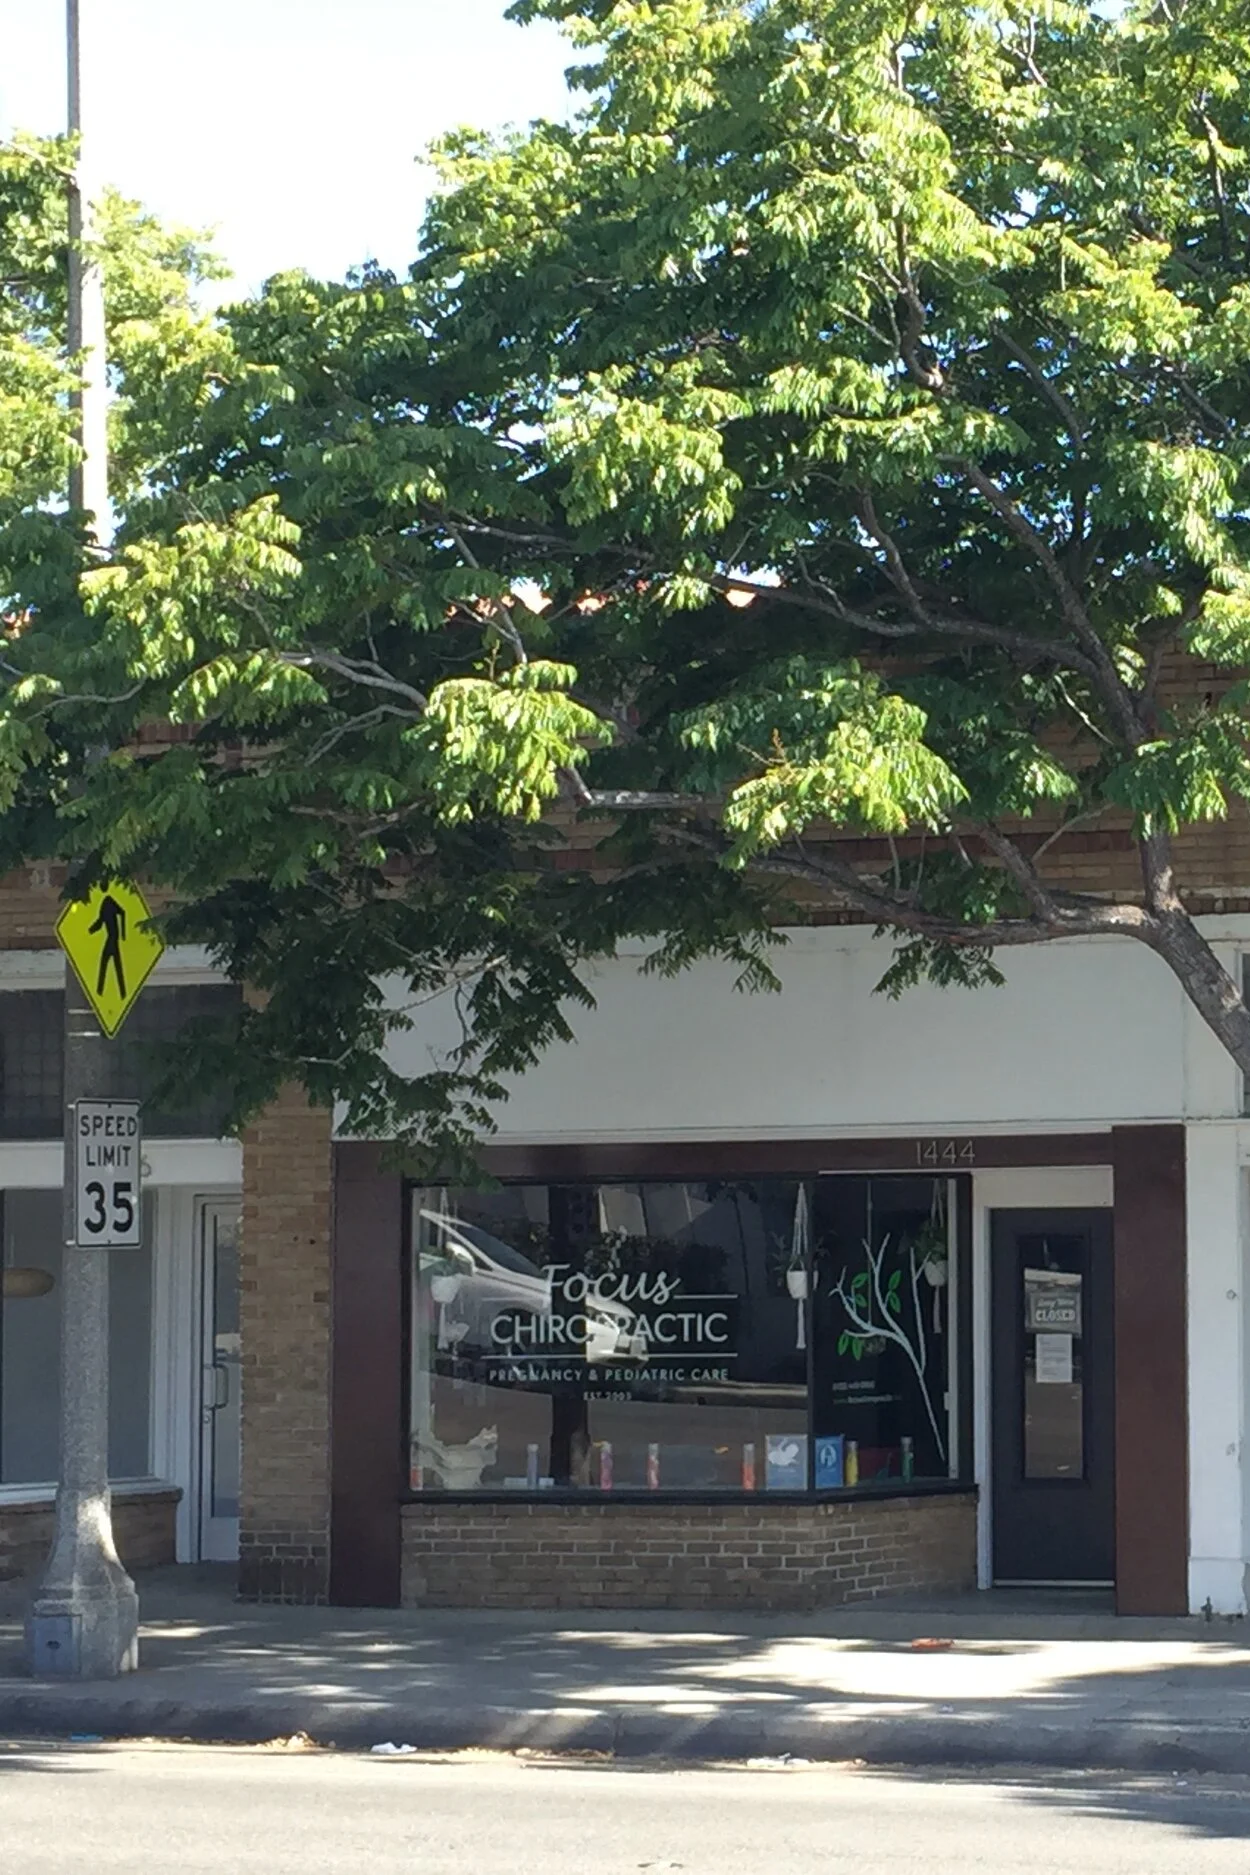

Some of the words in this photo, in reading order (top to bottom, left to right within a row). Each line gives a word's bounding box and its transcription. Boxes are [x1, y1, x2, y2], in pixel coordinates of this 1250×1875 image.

[80, 1115, 138, 1137] SPEED
[86, 1145, 131, 1167] LIMIT
[916, 1140, 976, 1165] 1444
[84, 1181, 134, 1234] 35
[540, 1263, 681, 1305] Focus
[488, 1368, 583, 1381] PREGNANCY
[588, 1368, 598, 1380] &
[605, 1368, 685, 1381] PEDIATRIC
[692, 1368, 729, 1380] CARE
